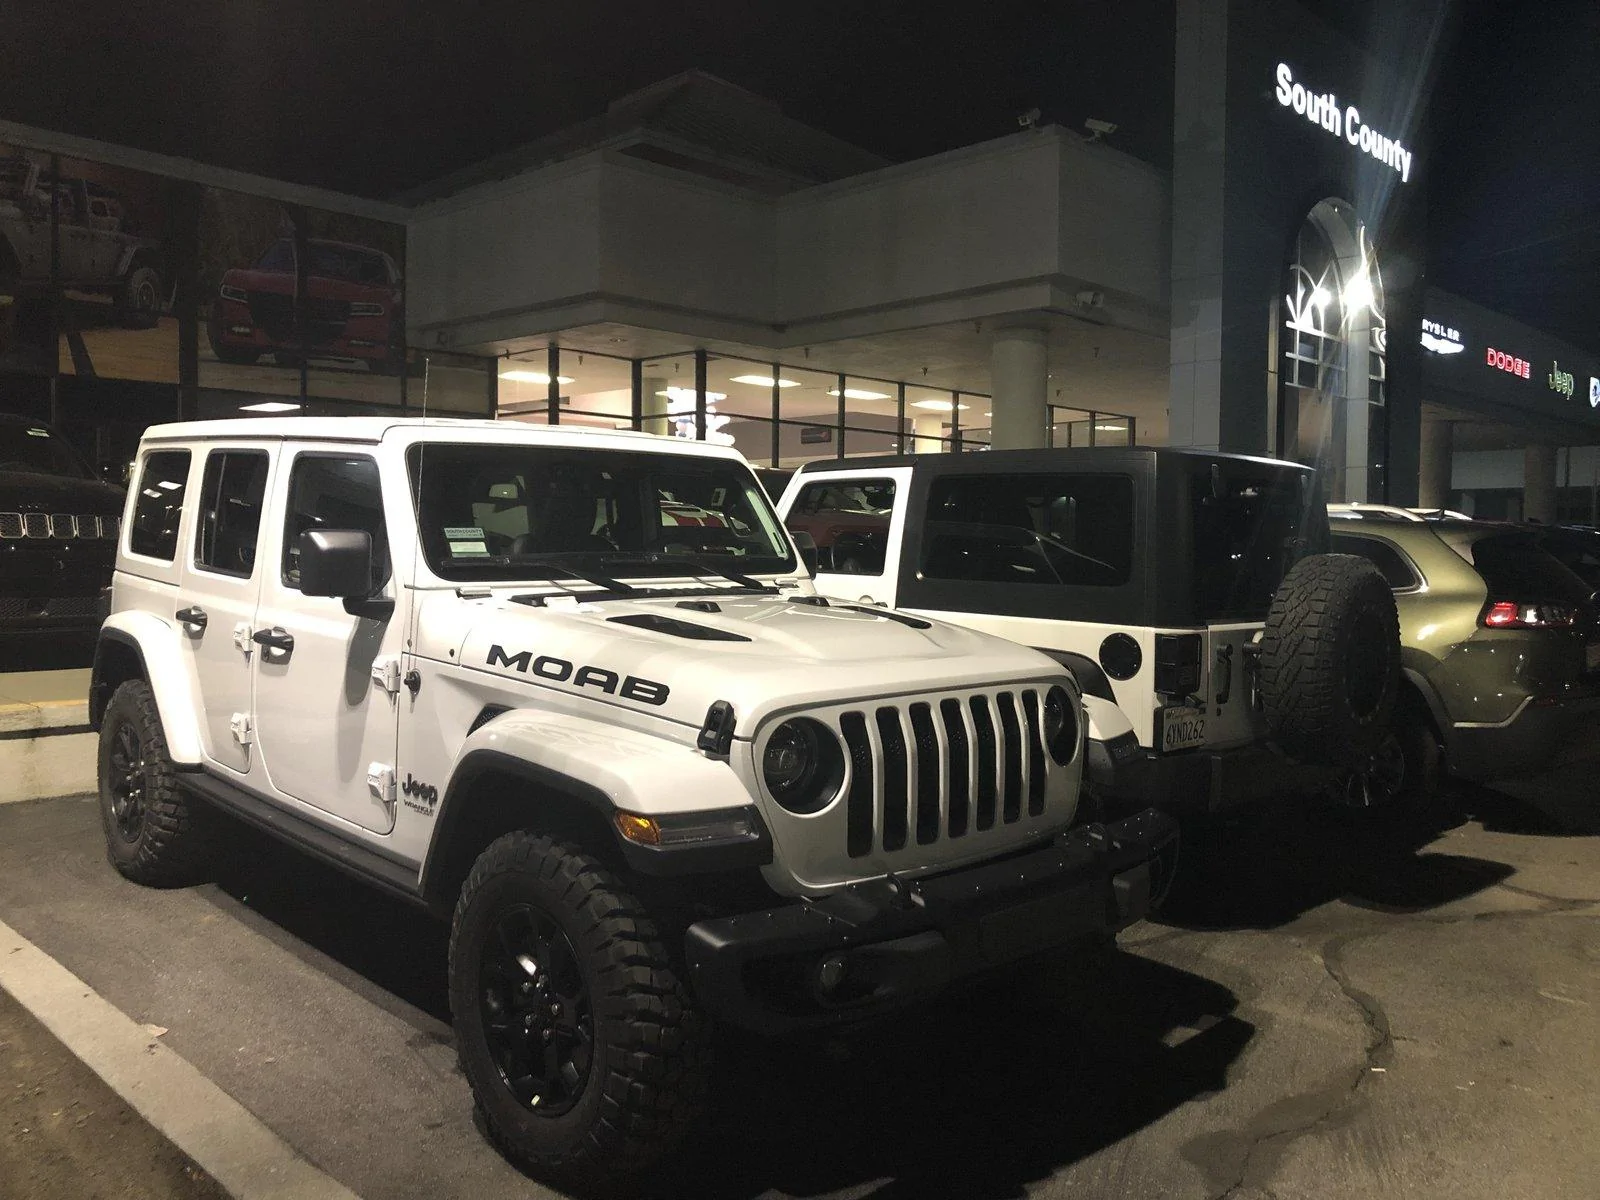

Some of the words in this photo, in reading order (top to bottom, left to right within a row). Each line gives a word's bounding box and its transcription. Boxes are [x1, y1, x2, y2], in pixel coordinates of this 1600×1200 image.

[1276, 63, 1341, 137] South
[1345, 106, 1412, 183] County
[1422, 318, 1460, 342] RYSLER
[1487, 347, 1530, 379] DODGE
[1548, 360, 1574, 401] Jeep
[486, 644, 670, 706] MOAB
[402, 772, 438, 807] Jeep
